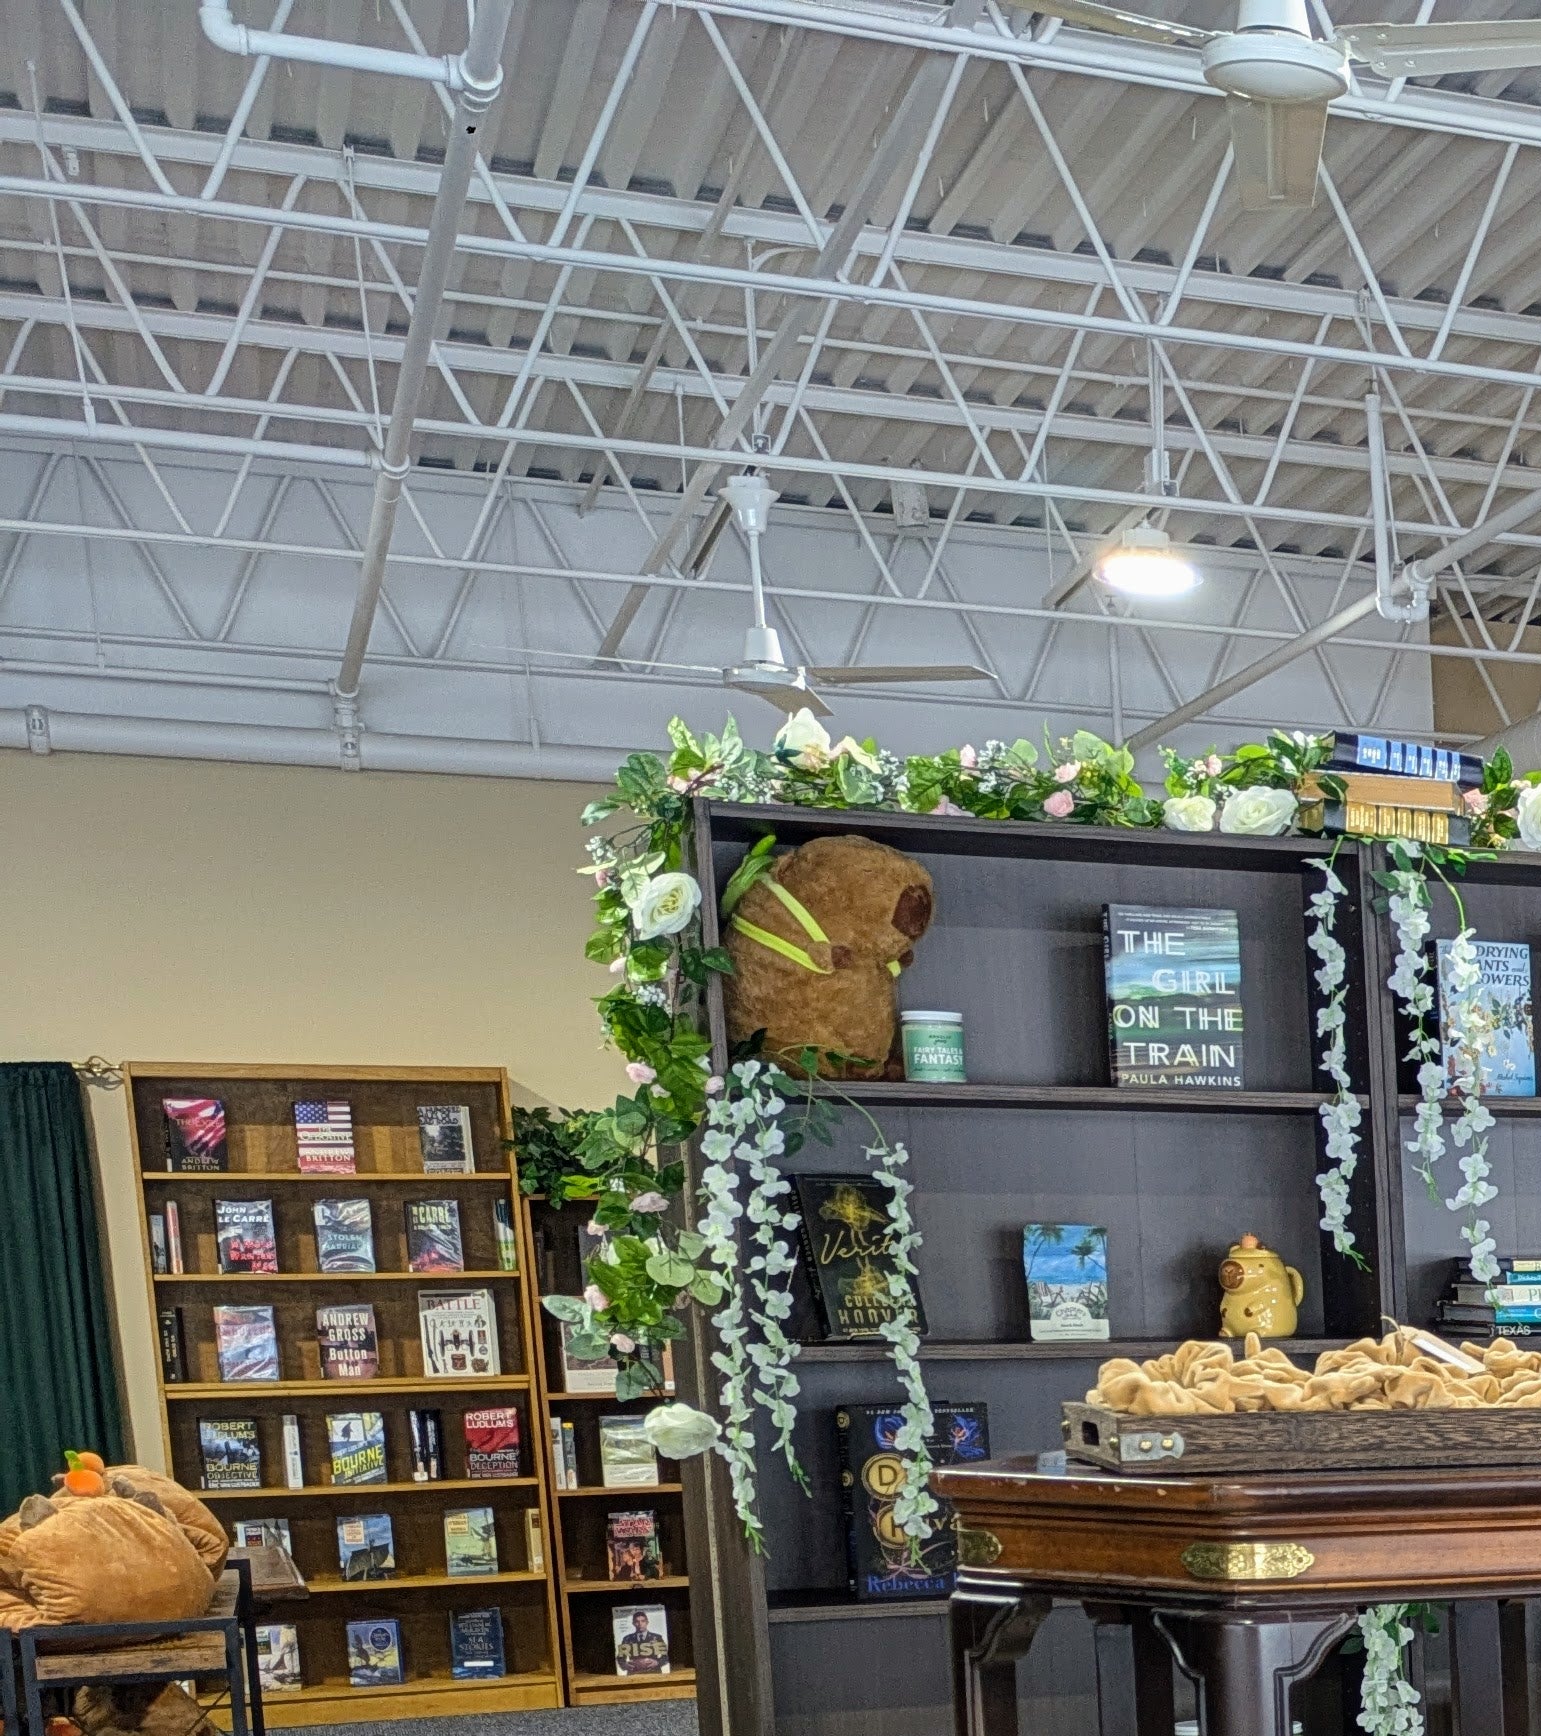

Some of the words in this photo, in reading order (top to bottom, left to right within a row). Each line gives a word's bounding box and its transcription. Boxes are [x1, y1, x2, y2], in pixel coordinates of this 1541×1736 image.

[1117, 931, 1185, 955] THE
[1152, 969, 1235, 994] GIRL
[1113, 1005, 1159, 1028] ON
[1174, 1006, 1243, 1031] THE
[1123, 1043, 1235, 1068] TRAIN
[1121, 1073, 1167, 1084] PAULA
[1174, 1076, 1241, 1086] HAWKINS
[217, 1206, 246, 1214] JOHN
[427, 1298, 482, 1311] BATTLE
[322, 1312, 369, 1326] ANDREW
[328, 1328, 366, 1342] GROSS
[1496, 1326, 1531, 1335] TEXAS
[329, 1348, 367, 1360] Button
[338, 1363, 362, 1376] Man
[466, 1412, 512, 1420] ROBERT
[202, 1422, 254, 1430] ROBERT
[470, 1453, 516, 1461] BOURNE
[206, 1464, 257, 1472] BOURNE
[471, 1461, 519, 1470] DECEPTION
[867, 1573, 945, 1593] Rebecca
[619, 1642, 667, 1657] RISE
